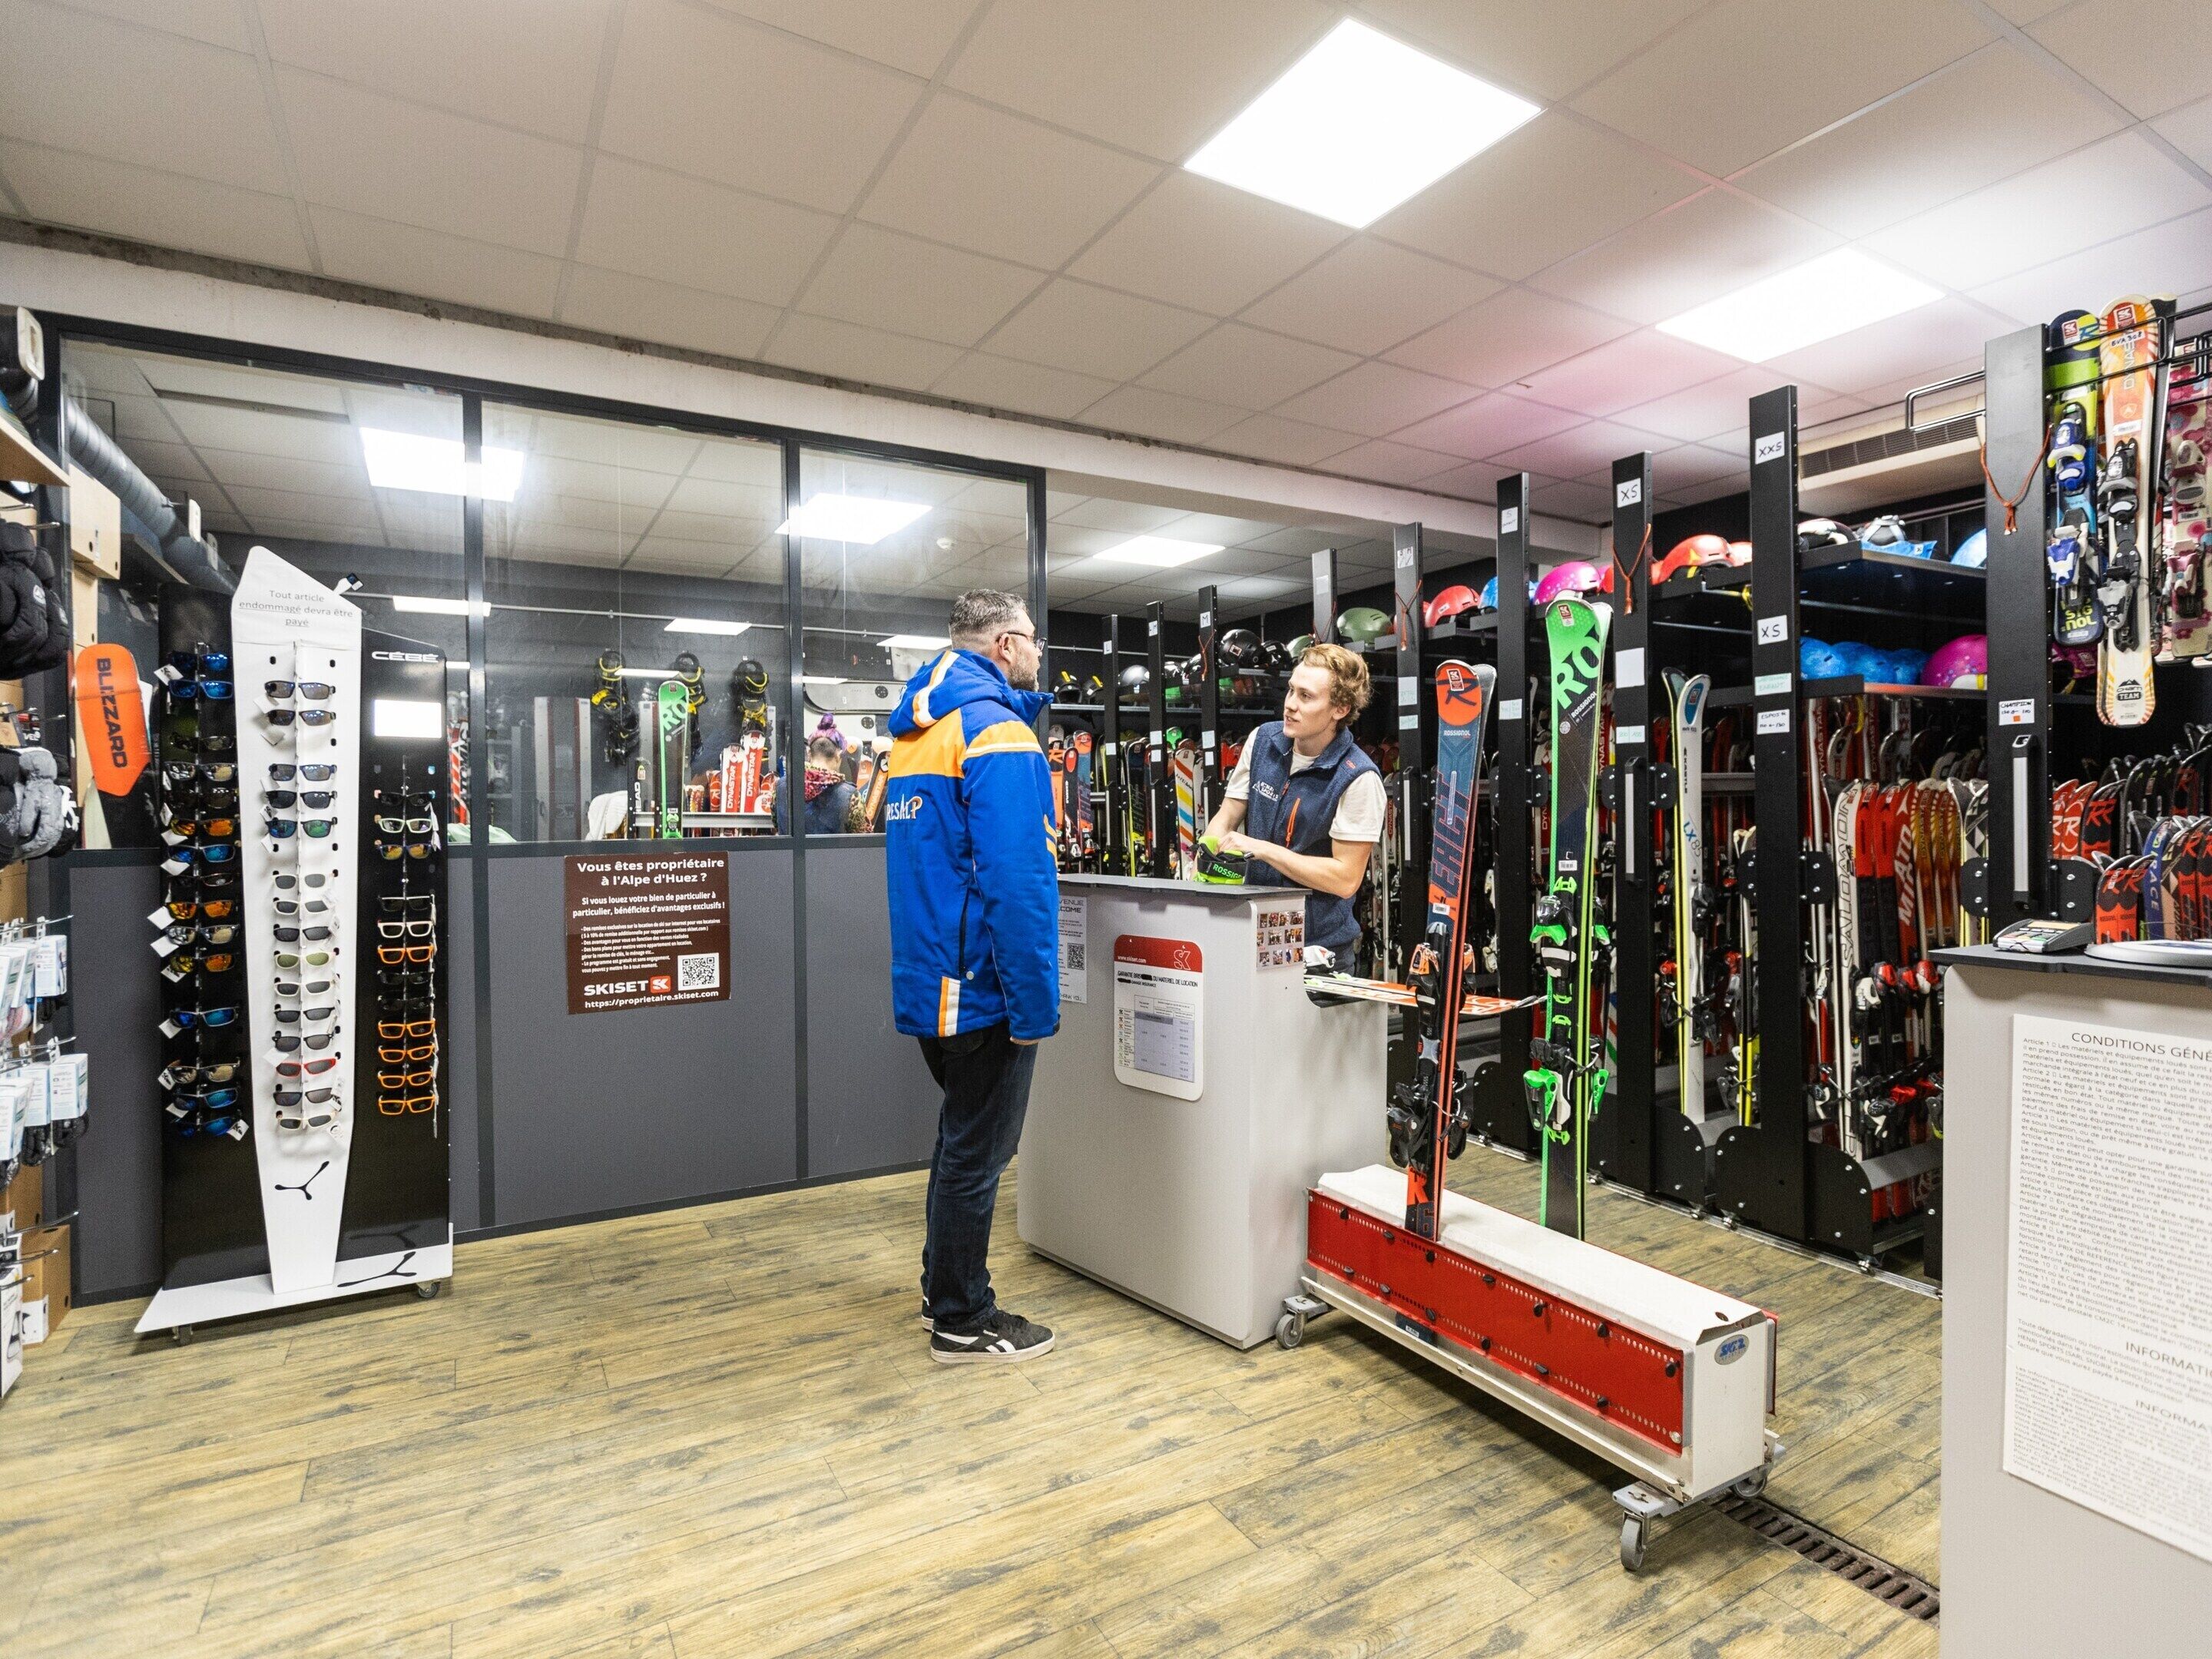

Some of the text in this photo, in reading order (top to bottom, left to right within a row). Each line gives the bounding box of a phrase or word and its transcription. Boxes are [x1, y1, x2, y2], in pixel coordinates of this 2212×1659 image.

[1759, 439, 1783, 458] XXS
[1621, 485, 1637, 502] XS
[269, 590, 325, 603] Tout article
[239, 601, 353, 618] endommagé devra être
[285, 617, 309, 628] payé
[1202, 614, 1209, 625] M
[1762, 624, 1780, 637] XS
[2118, 692, 2141, 700] TEAM
[96, 657, 128, 768] BLIZZARD
[746, 751, 757, 796] DYNASTAR
[727, 765, 737, 809] DYNASTAR
[577, 857, 724, 873] Vous êtes propriétaire
[601, 872, 707, 888] à l'Alpe d'Huez ?
[608, 895, 628, 904] louez
[649, 893, 664, 902] bien
[665, 892, 674, 901] de
[675, 891, 710, 902] particulier
[572, 907, 613, 918] particulier,
[614, 905, 650, 915] bénéficiez
[650, 902, 691, 914] d'avantages
[692, 901, 721, 910] exclusifs
[584, 979, 648, 996] SKISET
[1158, 976, 1175, 985] MATERIEL
[2071, 1032, 2166, 1055] CONDITIONS
[2023, 1037, 2045, 1046] Article
[2071, 1045, 2104, 1055] matériels
[2114, 1051, 2164, 1066] équipements
[2165, 1059, 2187, 1068] loués
[2038, 1047, 2058, 1056] prend
[2119, 1061, 2148, 1070] assume
[2022, 1051, 2054, 1062] matériels
[2063, 1058, 2110, 1072] équipements
[2022, 1058, 2061, 1071] marchande
[2135, 1399, 2212, 1432] INFORMA
